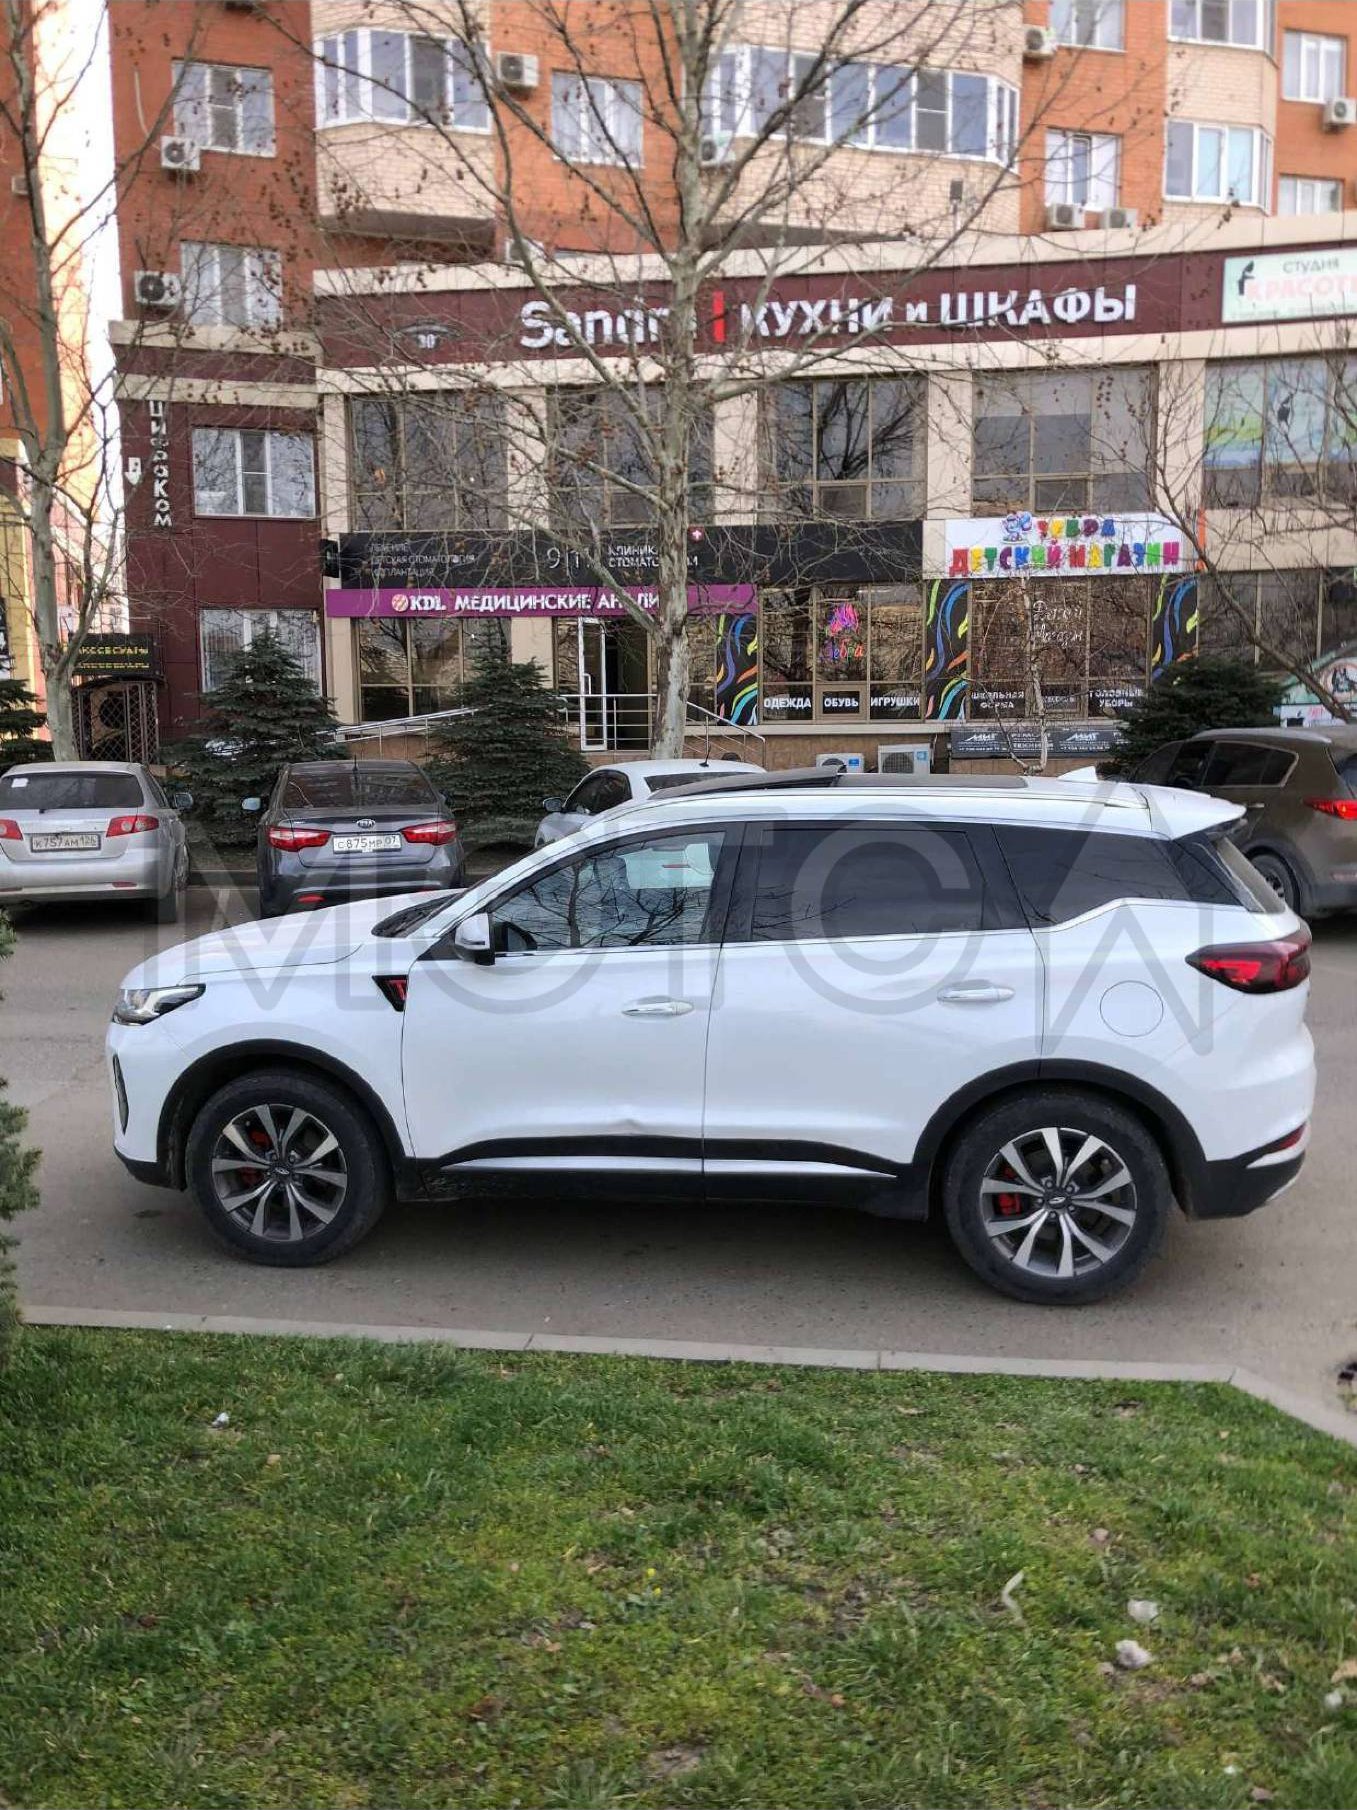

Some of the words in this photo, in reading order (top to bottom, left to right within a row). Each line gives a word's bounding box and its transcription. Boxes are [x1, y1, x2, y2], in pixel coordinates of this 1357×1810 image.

[741, 295, 894, 338] КУХНИ
[941, 283, 1137, 329] ШКАФЫ
[520, 296, 698, 349] Sandr
[608, 545, 658, 556] КЛИНИК
[949, 539, 1062, 577] ДЕТСКИЙ
[1068, 541, 1180, 569] МАГАЗИН
[409, 595, 447, 611] KDL
[454, 593, 592, 612] МЕДИЦИНСКИЕ
[763, 697, 812, 709] ОДЕЖДА
[823, 696, 859, 708] ОБУВЬ
[870, 695, 920, 707] ИГРУШКИ
